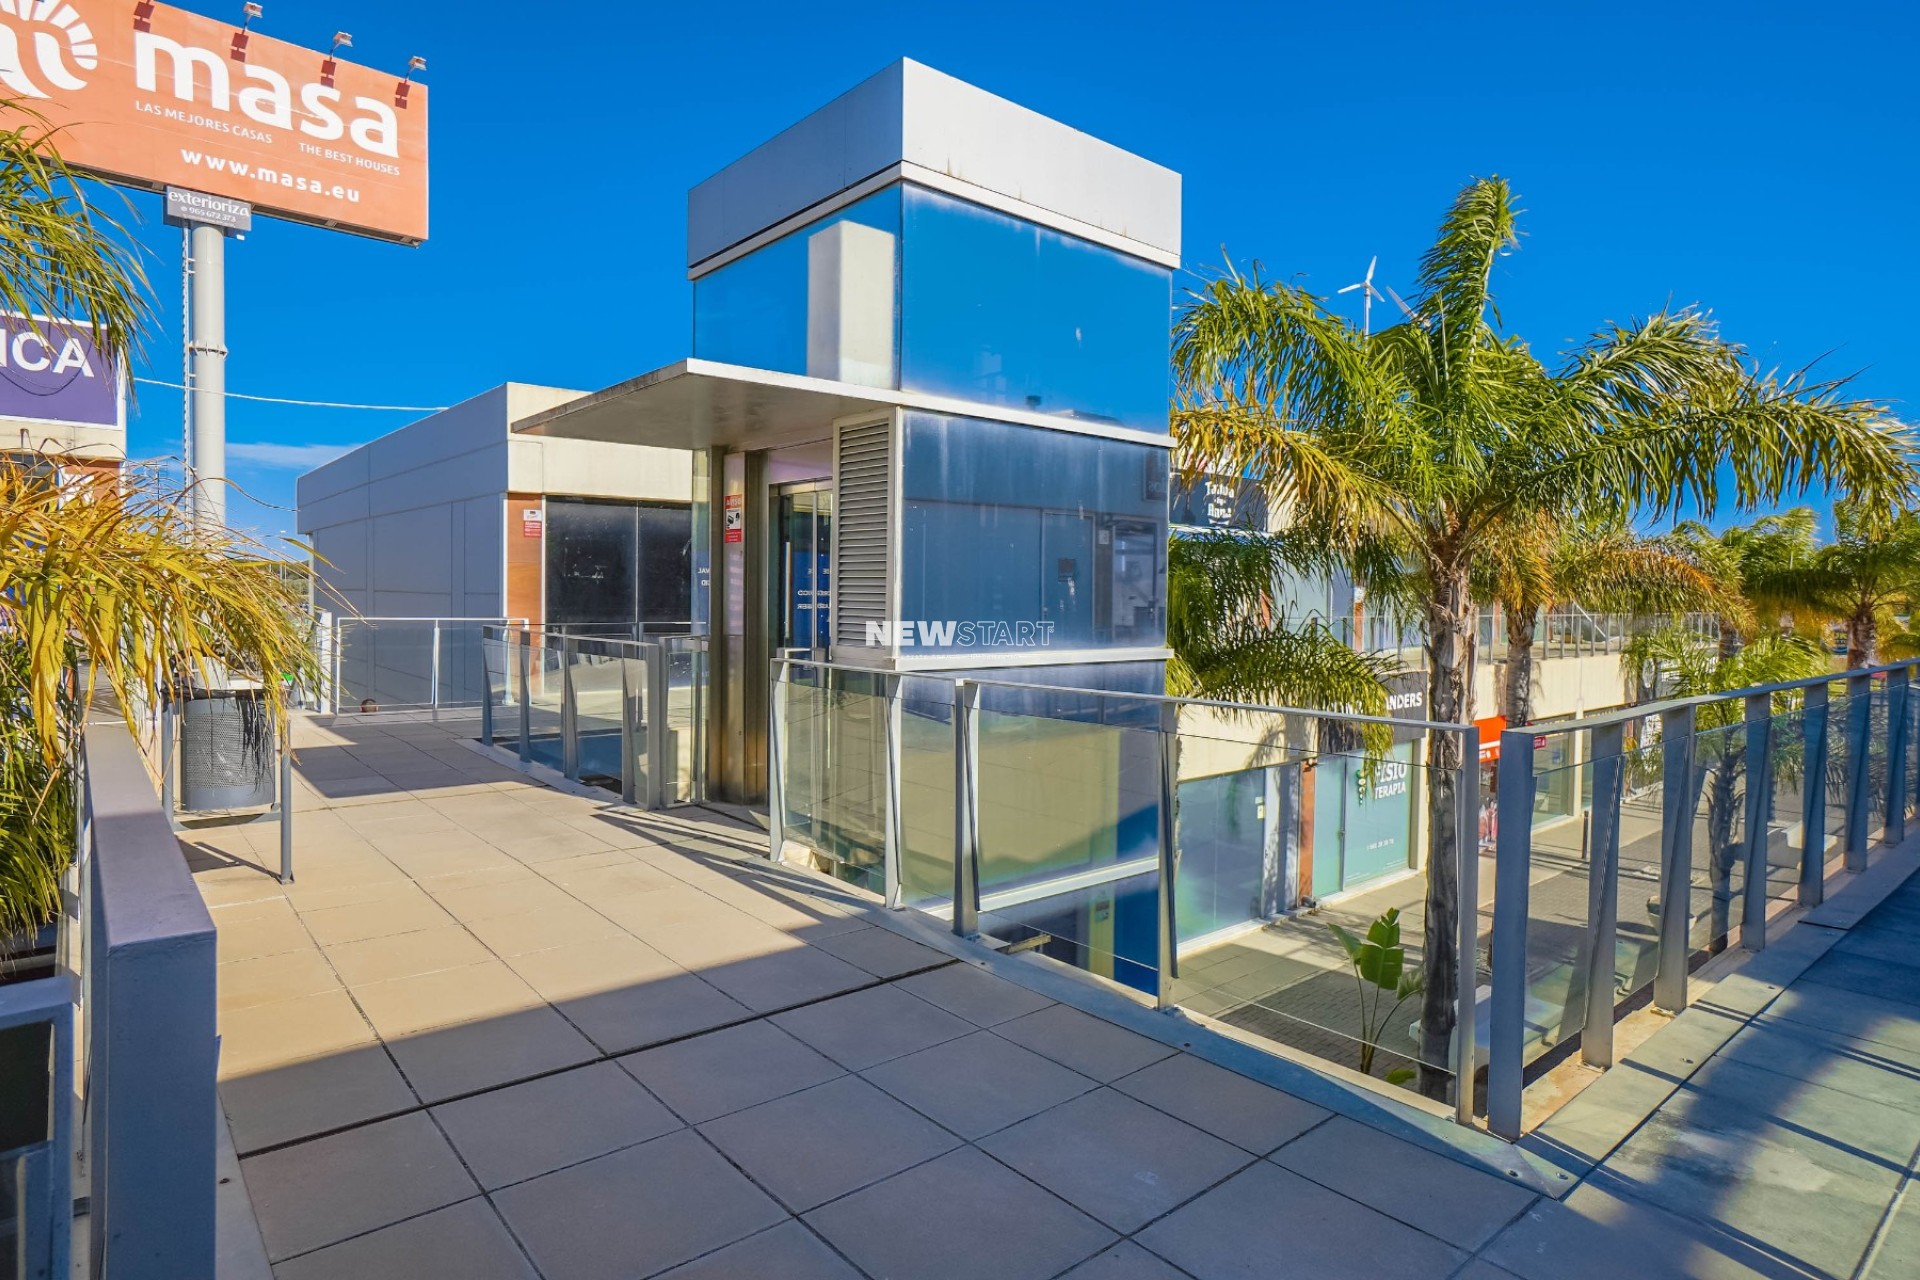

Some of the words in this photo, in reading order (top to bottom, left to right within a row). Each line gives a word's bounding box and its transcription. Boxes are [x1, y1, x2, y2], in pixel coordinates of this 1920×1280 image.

[134, 31, 399, 159] masa
[135, 100, 161, 116] LAS
[164, 108, 230, 133] MEJORES
[232, 125, 273, 144] CASAS
[181, 149, 360, 202] www.masa.eu
[298, 142, 322, 157] THE
[325, 148, 353, 164] BEST
[355, 157, 400, 176] HOUSES
[168, 191, 250, 217] exterioriza
[1374, 781, 1406, 800] TERAPIA
